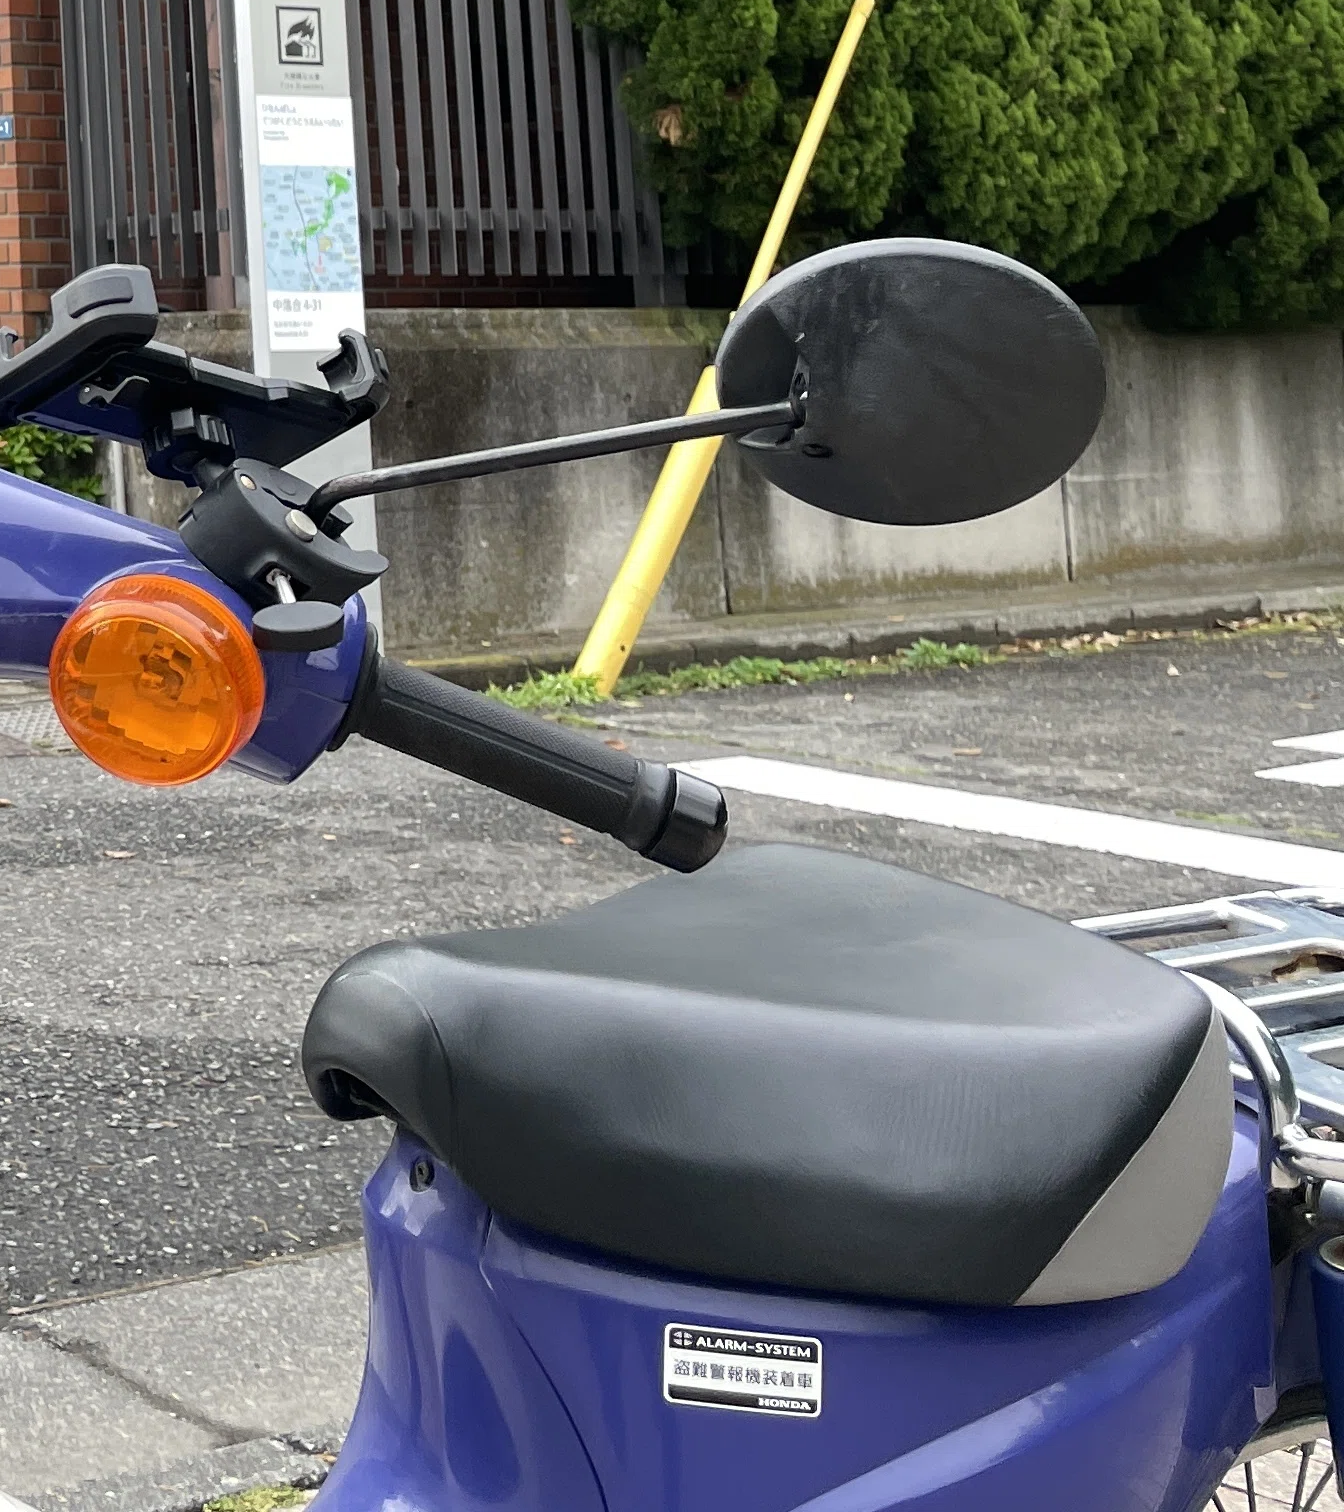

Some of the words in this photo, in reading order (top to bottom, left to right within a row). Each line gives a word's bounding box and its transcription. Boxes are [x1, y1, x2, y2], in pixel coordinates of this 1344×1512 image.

[696, 1336, 811, 1358] ALARM-SYSTEM
[674, 1359, 813, 1389] 盗難警報機装着車
[758, 1397, 812, 1411] HONDA
